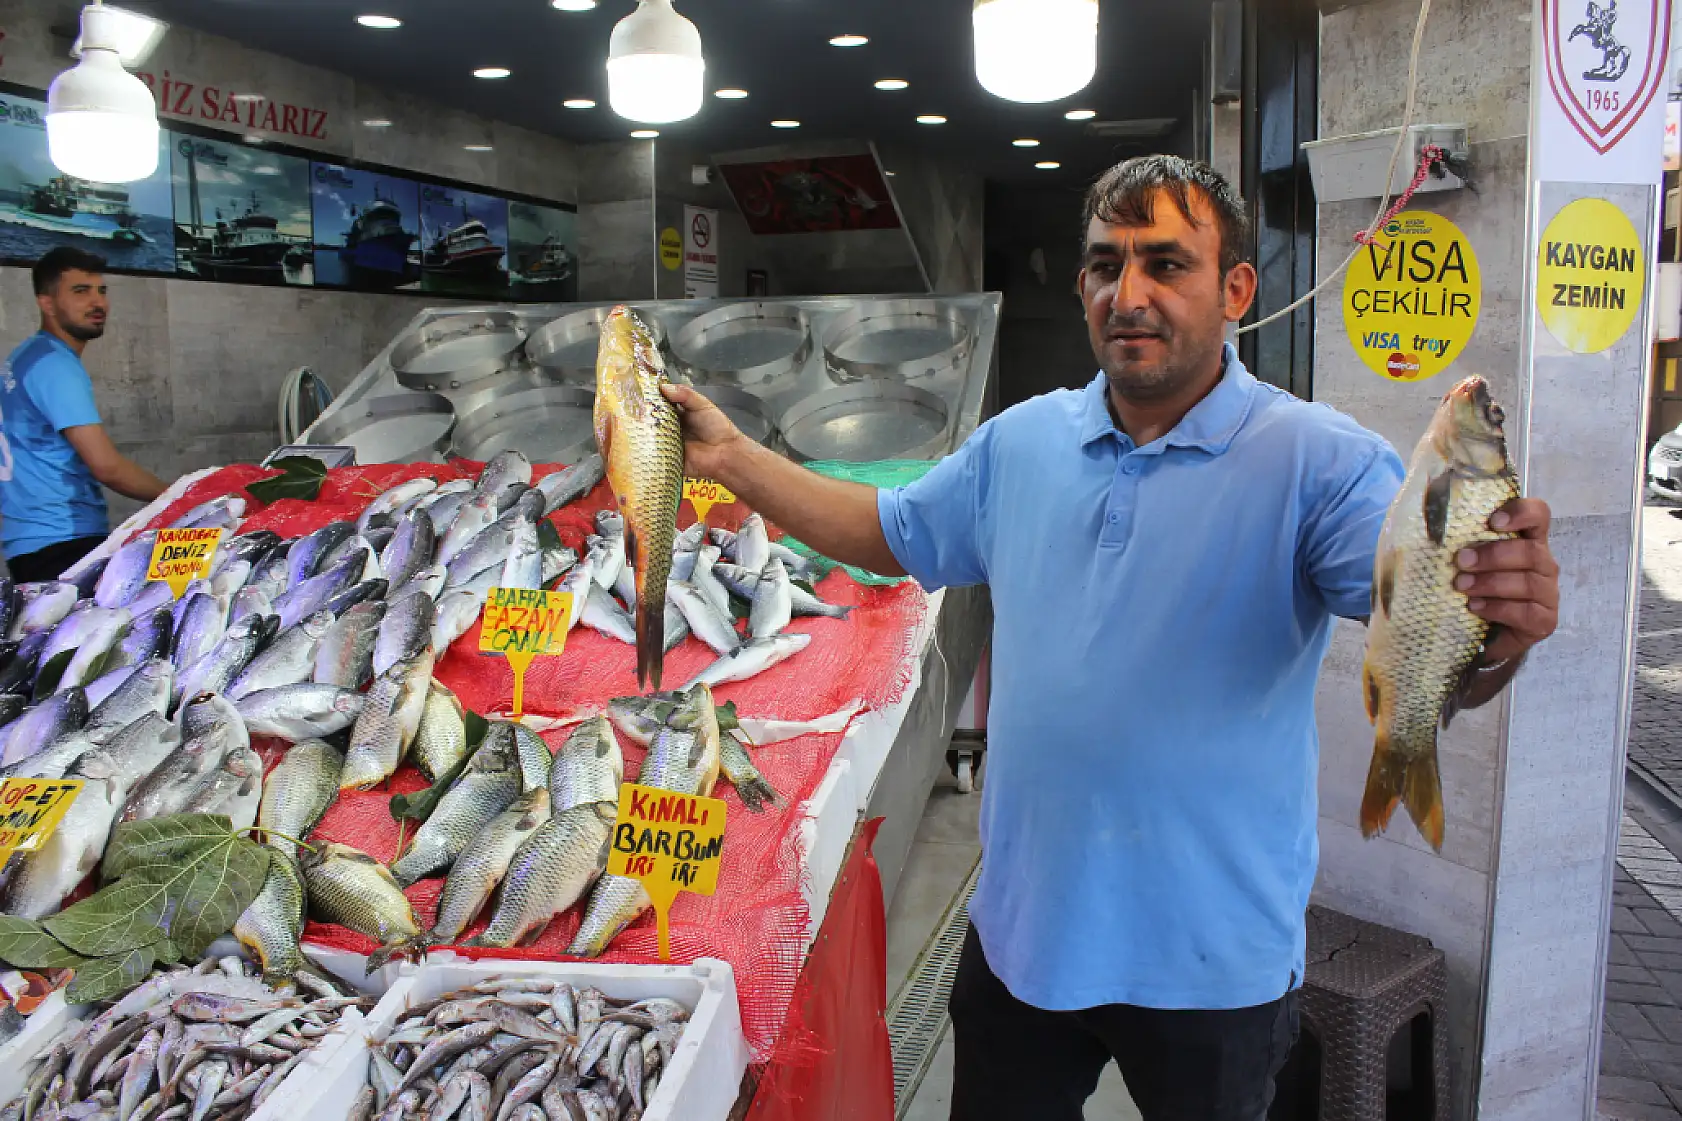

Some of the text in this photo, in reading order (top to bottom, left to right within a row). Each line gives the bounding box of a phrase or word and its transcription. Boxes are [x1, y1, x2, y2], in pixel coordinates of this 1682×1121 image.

[200, 86, 328, 140] SATARIZ
[1587, 89, 1619, 111] 1965
[1369, 239, 1469, 284] VISA
[1545, 241, 1635, 272] KAYGAN
[1351, 287, 1471, 318] ÇEKİLİR
[1552, 281, 1625, 310] ZEMİN
[1362, 331, 1451, 358] VISA troy
[629, 789, 709, 825] KINALI
[613, 823, 724, 861] BARBUN
